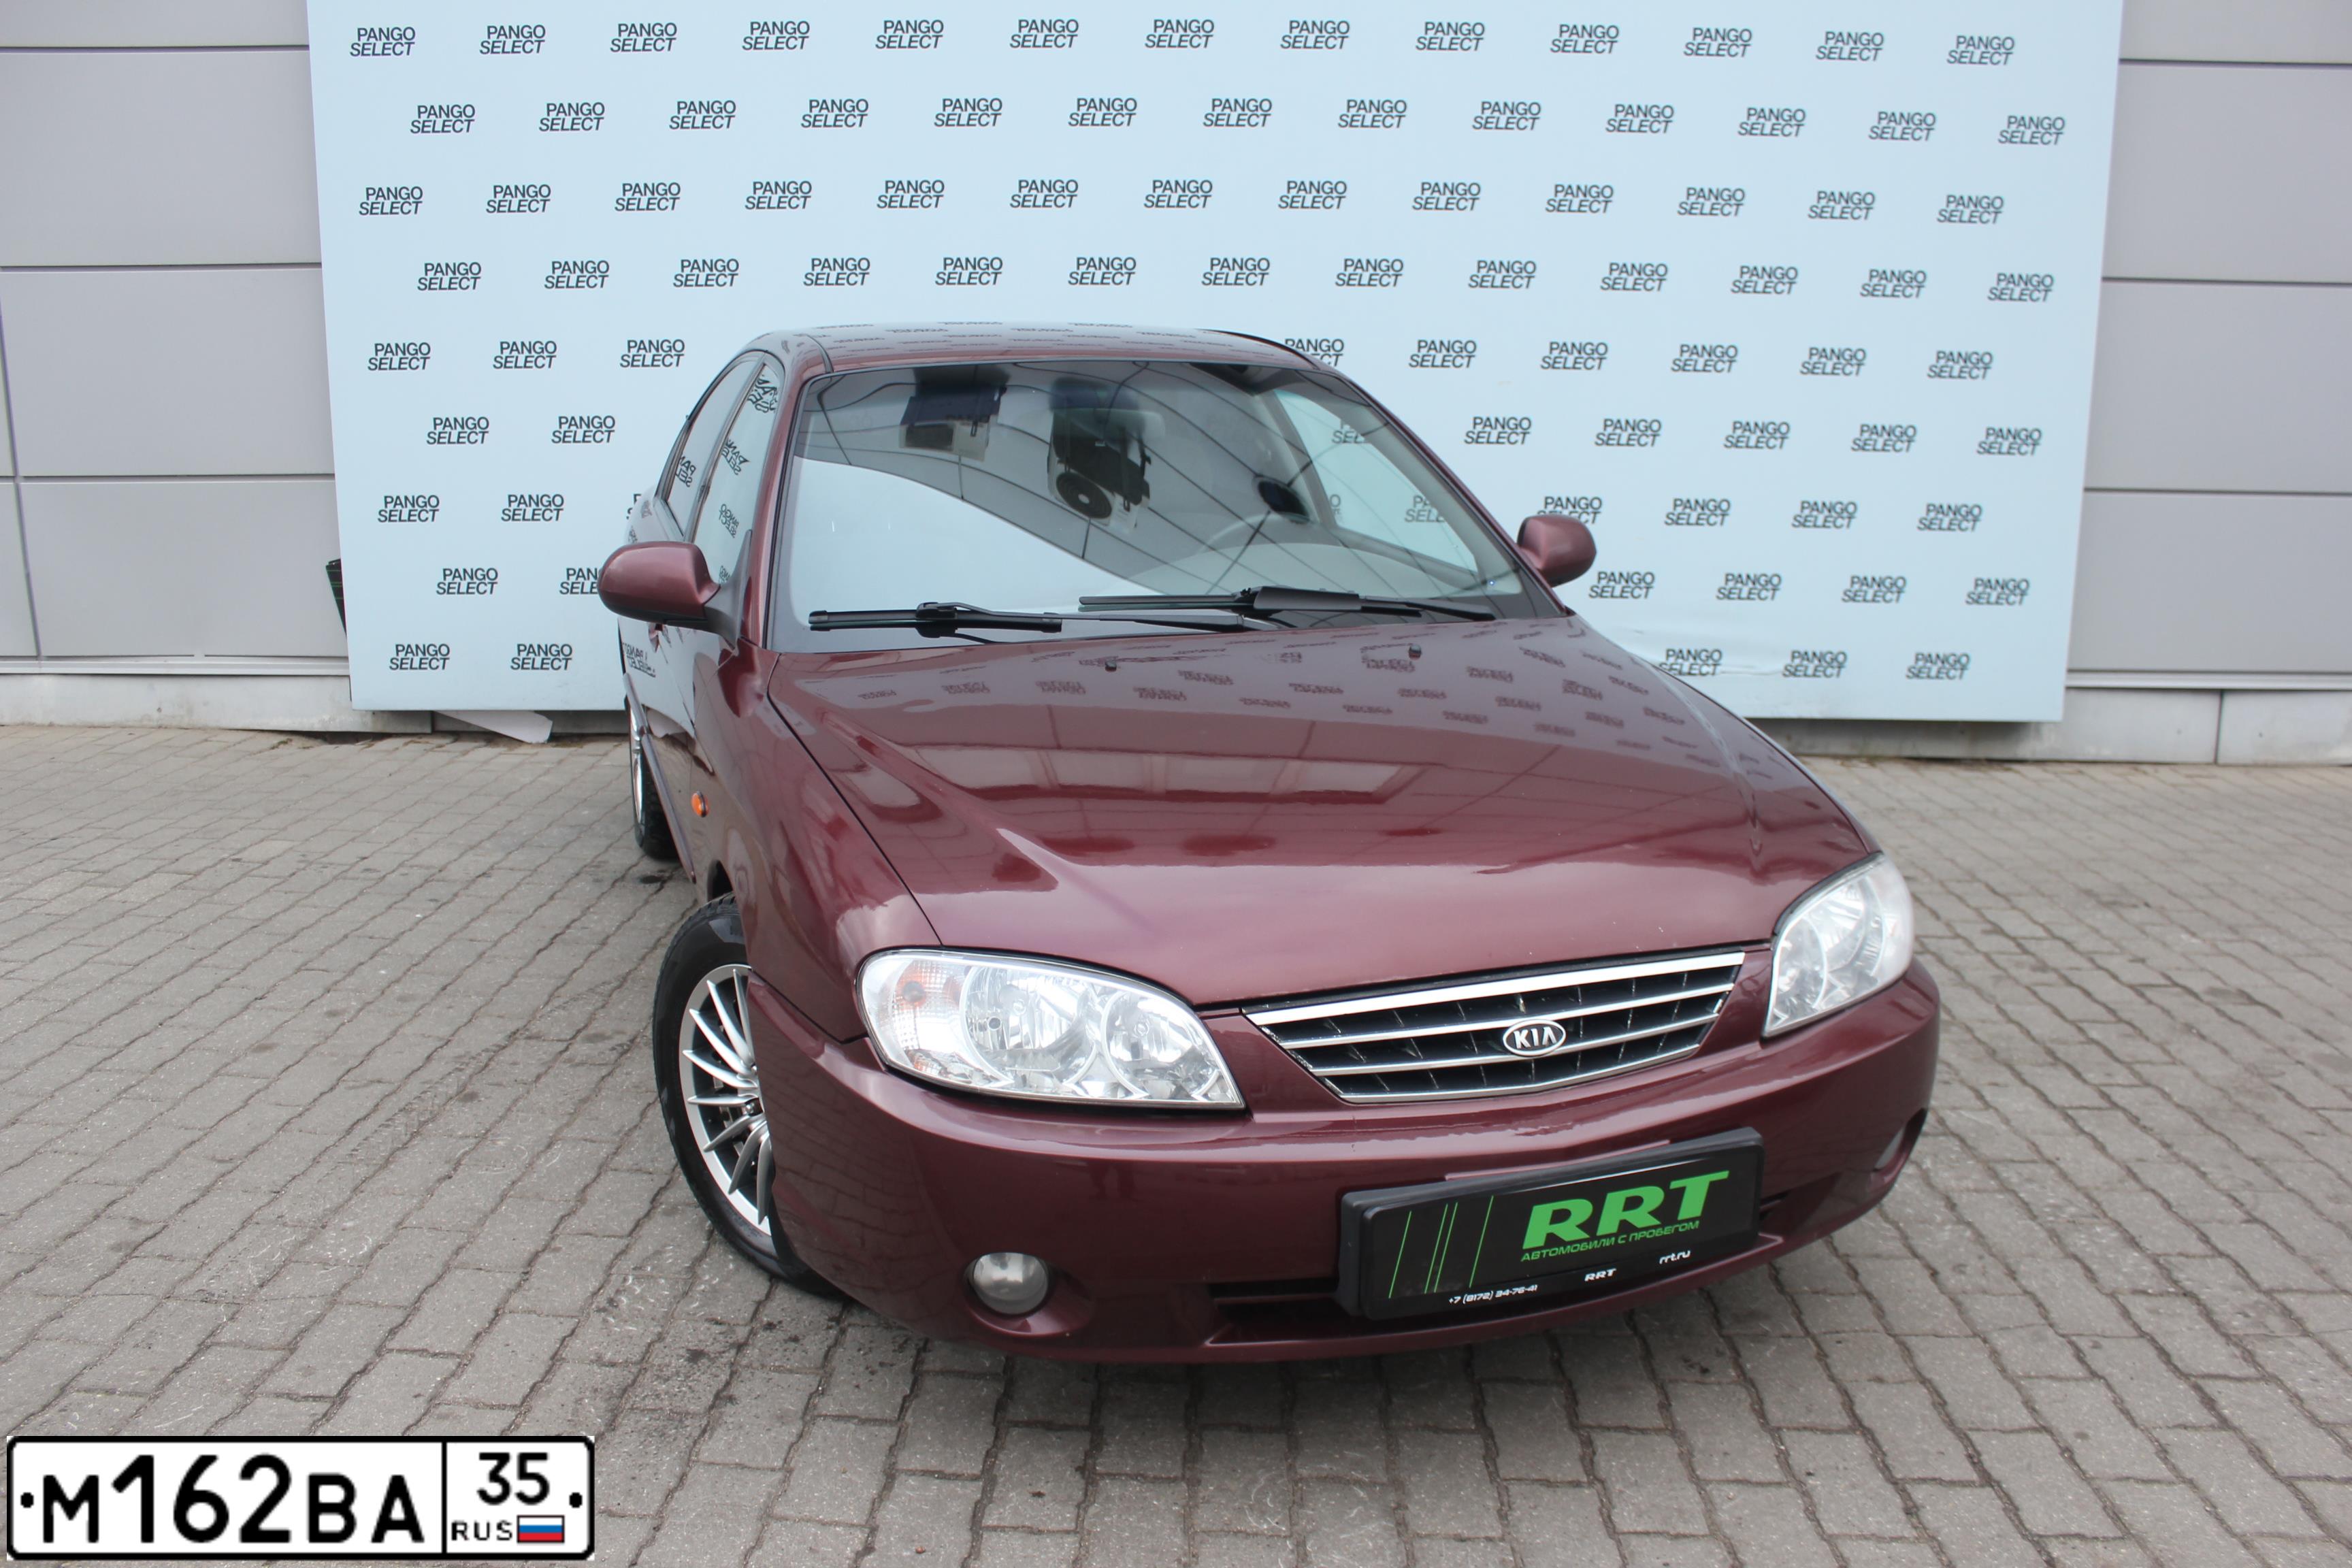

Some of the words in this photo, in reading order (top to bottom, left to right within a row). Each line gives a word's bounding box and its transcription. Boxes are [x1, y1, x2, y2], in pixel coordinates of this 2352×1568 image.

[487, 24, 546, 39] PANGO
[751, 20, 810, 35] PANGO
[884, 20, 944, 34] PANGO
[1154, 19, 1214, 33] PANGO
[1290, 20, 1350, 35] PANGO
[1559, 24, 1619, 39] PANGO
[357, 27, 415, 42] PANGO
[1145, 33, 1213, 48] SELECT
[1693, 27, 1752, 43] PANGO
[350, 42, 415, 56] SELECT
[480, 39, 545, 54] SELECT
[742, 36, 809, 50] SELECT
[875, 35, 943, 49] SELECT
[1280, 35, 1349, 49] SELECT
[1550, 39, 1618, 54] SELECT
[1957, 35, 2014, 51] PANGO
[1684, 42, 1750, 57] SELECT
[1947, 50, 2013, 65] SELECT
[417, 104, 475, 118] PANGO
[677, 100, 736, 115] PANGO
[809, 99, 868, 113] PANGO
[1077, 98, 1137, 112] PANGO
[1347, 99, 1407, 114] PANGO
[1482, 101, 1541, 116] PANGO
[669, 115, 735, 129] SELECT
[801, 114, 868, 128] SELECT
[1068, 112, 1136, 127] SELECT
[1338, 114, 1406, 129] SELECT
[1747, 108, 1806, 122] PANGO
[410, 119, 475, 133] SELECT
[1473, 116, 1539, 131] SELECT
[1738, 122, 1804, 137] SELECT
[2008, 116, 2065, 131] PANGO
[1998, 130, 2063, 145] SELECT
[365, 186, 423, 201] PANGO
[493, 184, 551, 199] PANGO
[753, 180, 812, 195] PANGO
[885, 180, 945, 194] PANGO
[1153, 180, 1213, 194] PANGO
[1287, 180, 1347, 195] PANGO
[1554, 184, 1614, 199] PANGO
[745, 195, 811, 210] SELECT
[877, 194, 944, 208] SELECT
[1144, 194, 1211, 208] SELECT
[1278, 195, 1346, 209] SELECT
[1817, 191, 1875, 206] PANGO
[1946, 195, 2004, 210] PANGO
[359, 201, 423, 216] SELECT
[486, 199, 551, 213] SELECT
[1546, 199, 1612, 213] SELECT
[1808, 205, 1873, 220] SELECT
[1937, 208, 2002, 224] SELECT
[425, 262, 481, 276] PANGO
[681, 259, 739, 273] PANGO
[943, 257, 1002, 271] PANGO
[1077, 257, 1137, 271] PANGO
[1344, 259, 1403, 273] PANGO
[1610, 263, 1668, 278] PANGO
[935, 271, 1002, 285] SELECT
[1068, 271, 1135, 285] SELECT
[1740, 265, 1798, 280] PANGO
[417, 276, 481, 291] SELECT
[673, 273, 738, 287] SELECT
[1335, 273, 1403, 287] SELECT
[1601, 276, 1666, 291] SELECT
[1731, 280, 1796, 294] SELECT
[1997, 273, 2054, 288] PANGO
[1988, 287, 2052, 301] SELECT
[374, 342, 431, 357] PANGO
[500, 341, 557, 355] PANGO
[627, 339, 685, 353] PANGO
[1418, 340, 1477, 354] PANGO
[1550, 342, 1608, 356] PANGO
[1680, 344, 1738, 359] PANGO
[493, 355, 557, 369] SELECT
[620, 353, 684, 368] SELECT
[1409, 354, 1475, 368] SELECT
[1809, 347, 1866, 363] PANGO
[1936, 350, 1993, 365] PANGO
[368, 357, 430, 371] SELECT
[1541, 356, 1606, 370] SELECT
[1671, 358, 1736, 373] SELECT
[1800, 361, 1864, 376] SELECT
[1927, 364, 1991, 379] SELECT
[433, 416, 489, 430] PANGO
[559, 415, 615, 429] PANGO
[1473, 416, 1531, 431] PANGO
[1603, 419, 1661, 433] PANGO
[1733, 421, 1790, 436] PANGO
[427, 431, 489, 444] SELECT
[551, 429, 615, 444] SELECT
[1465, 430, 1530, 444] SELECT
[1860, 424, 1916, 439] PANGO
[1986, 427, 2042, 442] PANGO
[1595, 432, 1660, 446] SELECT
[1724, 434, 1788, 449] SELECT
[1851, 437, 1914, 452] SELECT
[1977, 440, 2040, 455] SELECT
[384, 495, 440, 508] PANGO
[508, 494, 564, 508] PANGO
[1544, 497, 1602, 510] PANGO
[1673, 498, 1731, 512] PANGO
[1801, 501, 1857, 515] PANGO
[378, 508, 439, 523] SELECT
[501, 508, 564, 521] SELECT
[1665, 511, 1729, 526] SELECT
[1926, 504, 1982, 519] PANGO
[1792, 513, 1855, 529] SELECT
[1917, 517, 1980, 532] SELECT
[443, 568, 498, 581] PANGO
[566, 568, 600, 581] PAN
[1598, 572, 1655, 586] PANGO
[1725, 573, 1782, 587] PANGO
[436, 581, 497, 595] SELECT
[559, 582, 599, 595] SELE
[1850, 576, 1906, 590] PANGO
[1974, 578, 2029, 593] PANGO
[1589, 585, 1653, 599] SELECT
[1716, 586, 1779, 600] SELECT
[1842, 589, 1904, 603] SELECT
[1965, 591, 2027, 605] SELECT
[395, 644, 450, 657] PANGO
[517, 644, 572, 657] PANGO
[1667, 649, 1722, 663] PANGO
[389, 657, 450, 670] SELECT
[510, 657, 572, 670] SELECT
[1791, 651, 1847, 666] PANGO
[1915, 653, 1970, 667] PANGO
[1782, 663, 1844, 678] SELECT
[1906, 665, 1967, 680] SELECT
[1514, 1026, 1557, 1049] KIA
[1522, 1171, 1729, 1250] RRT
[1520, 1237, 1615, 1262] АВТОМОБИЛИ
[1617, 1235, 1627, 1244] С
[1629, 1220, 1700, 1242] ПРОБЕГОМ
[1659, 1250, 1691, 1264] rrt.ru
[1584, 1268, 1617, 1281] RRT
[1449, 1296, 1461, 1304] +7
